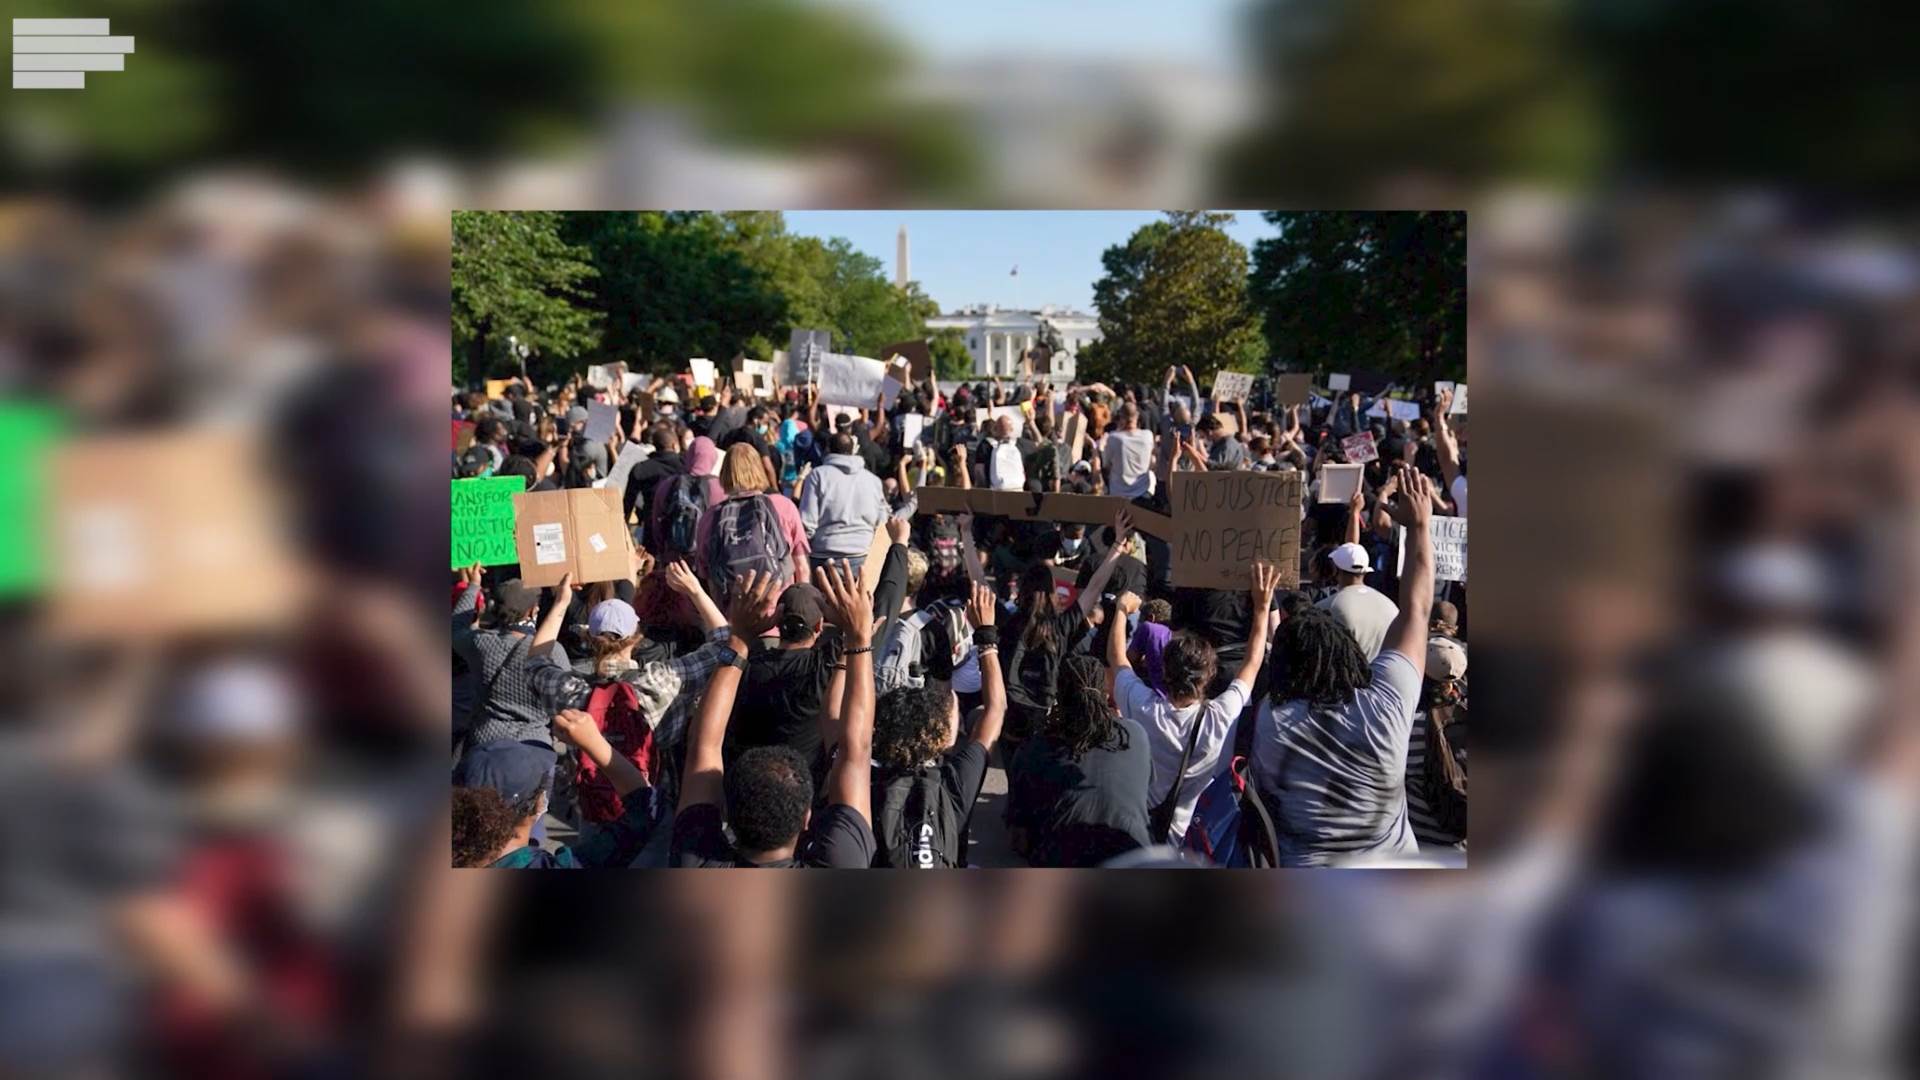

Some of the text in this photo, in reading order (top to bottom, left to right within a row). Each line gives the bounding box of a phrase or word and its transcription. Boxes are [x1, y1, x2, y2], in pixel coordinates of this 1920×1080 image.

[1183, 476, 1300, 512] NO JUSTICE
[1181, 527, 1297, 563] NO PEACE
[1430, 521, 1467, 539] TICE
[456, 538, 507, 562] NOW
